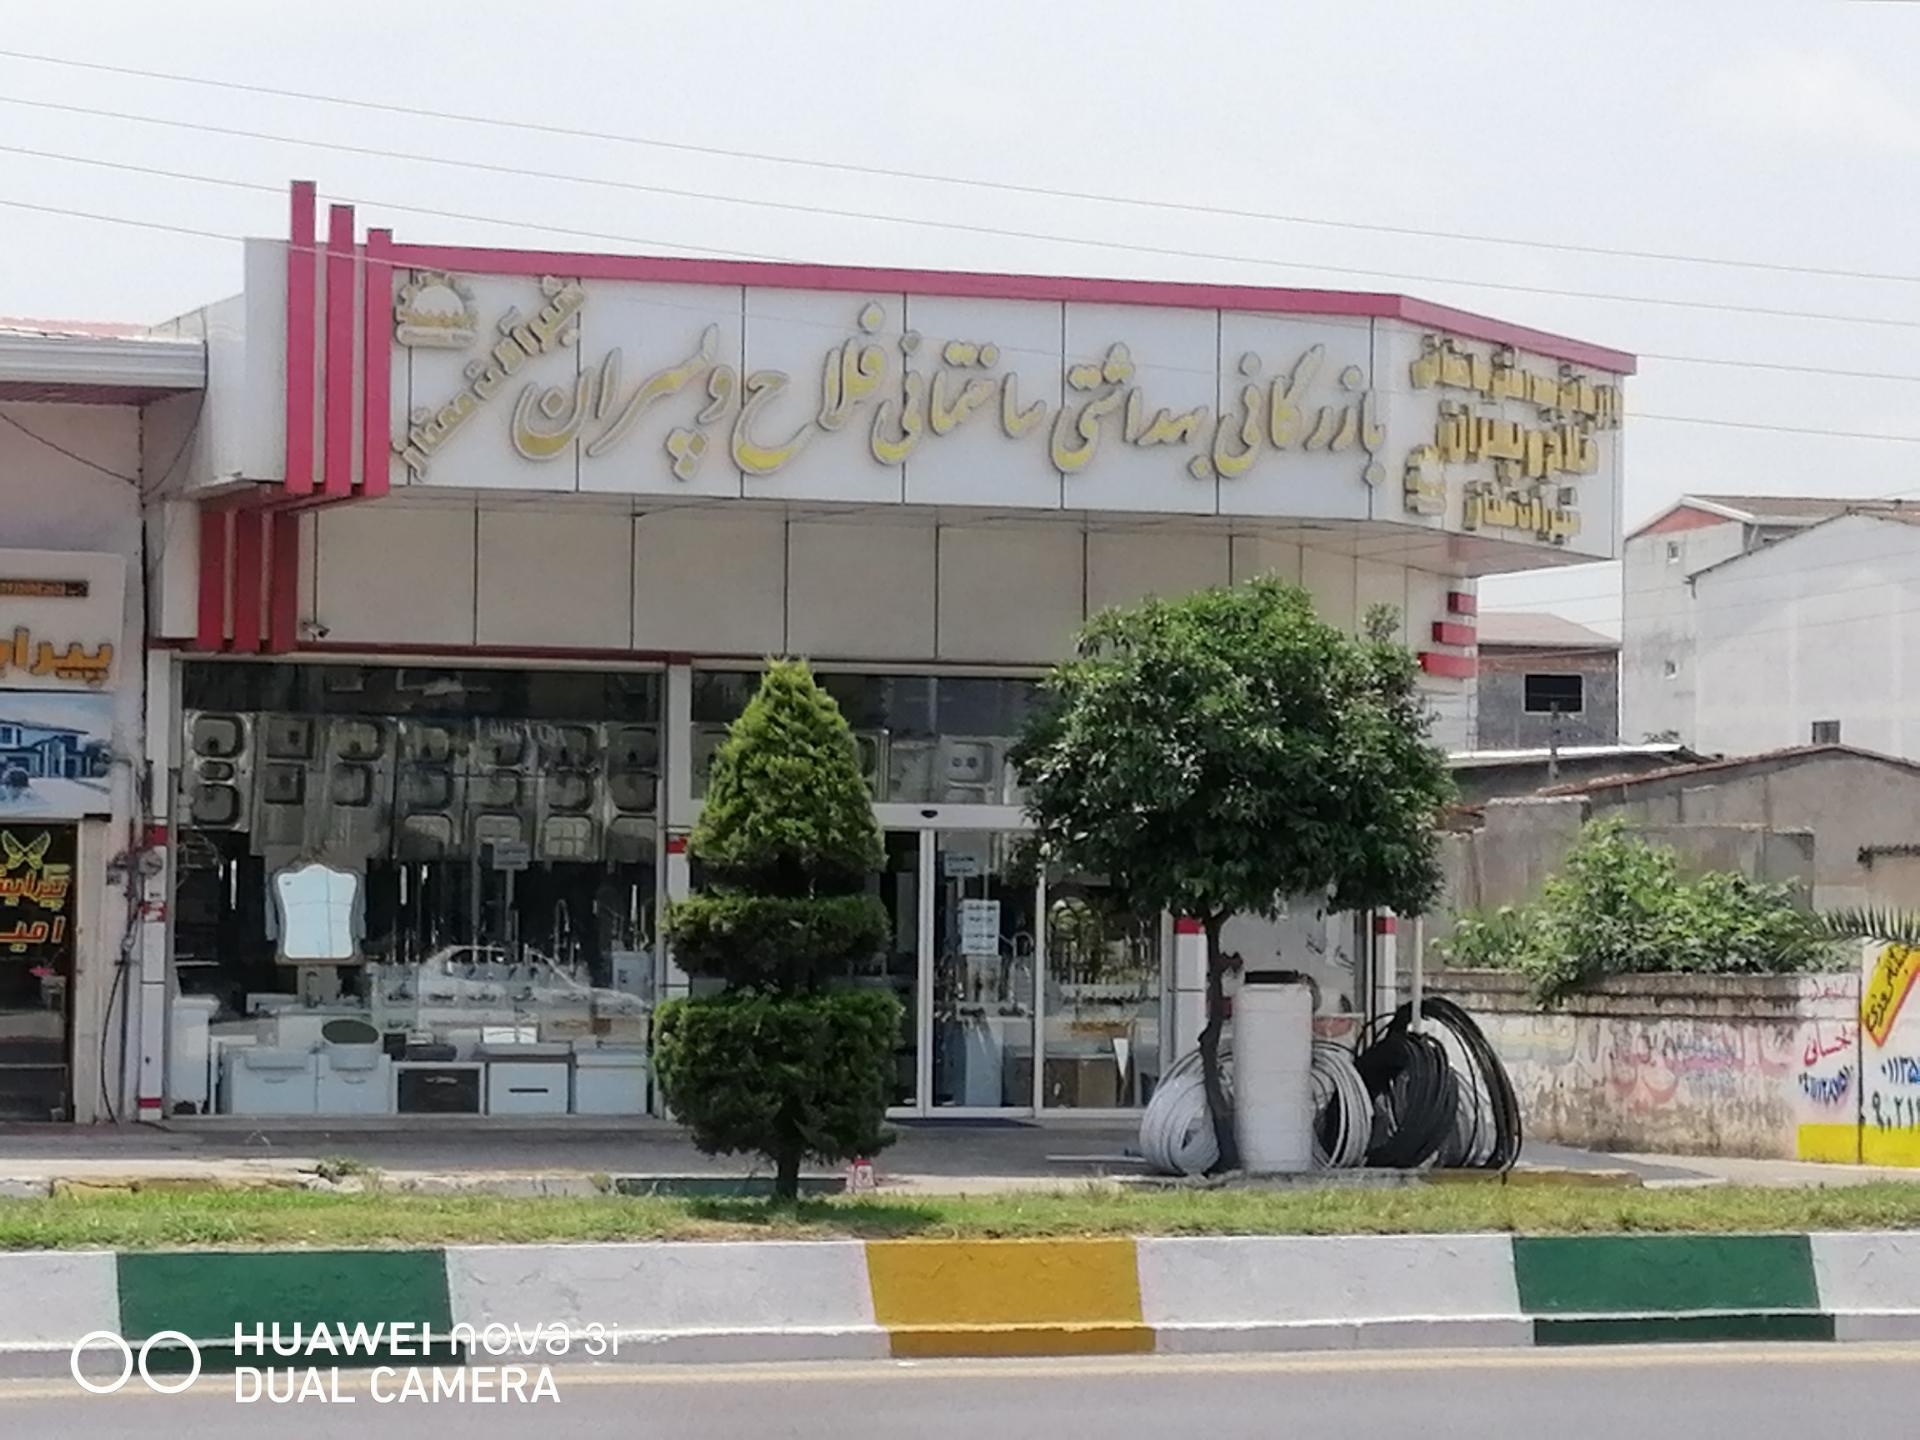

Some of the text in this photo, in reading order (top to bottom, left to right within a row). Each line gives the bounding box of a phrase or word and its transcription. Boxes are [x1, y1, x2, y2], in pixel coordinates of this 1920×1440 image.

[511, 322, 720, 482] پسران
[731, 302, 888, 476] فلاح
[870, 330, 1046, 467] ساختمانی
[1050, 342, 1212, 481] بهداشتی
[1212, 343, 1386, 487] بازرگانی
